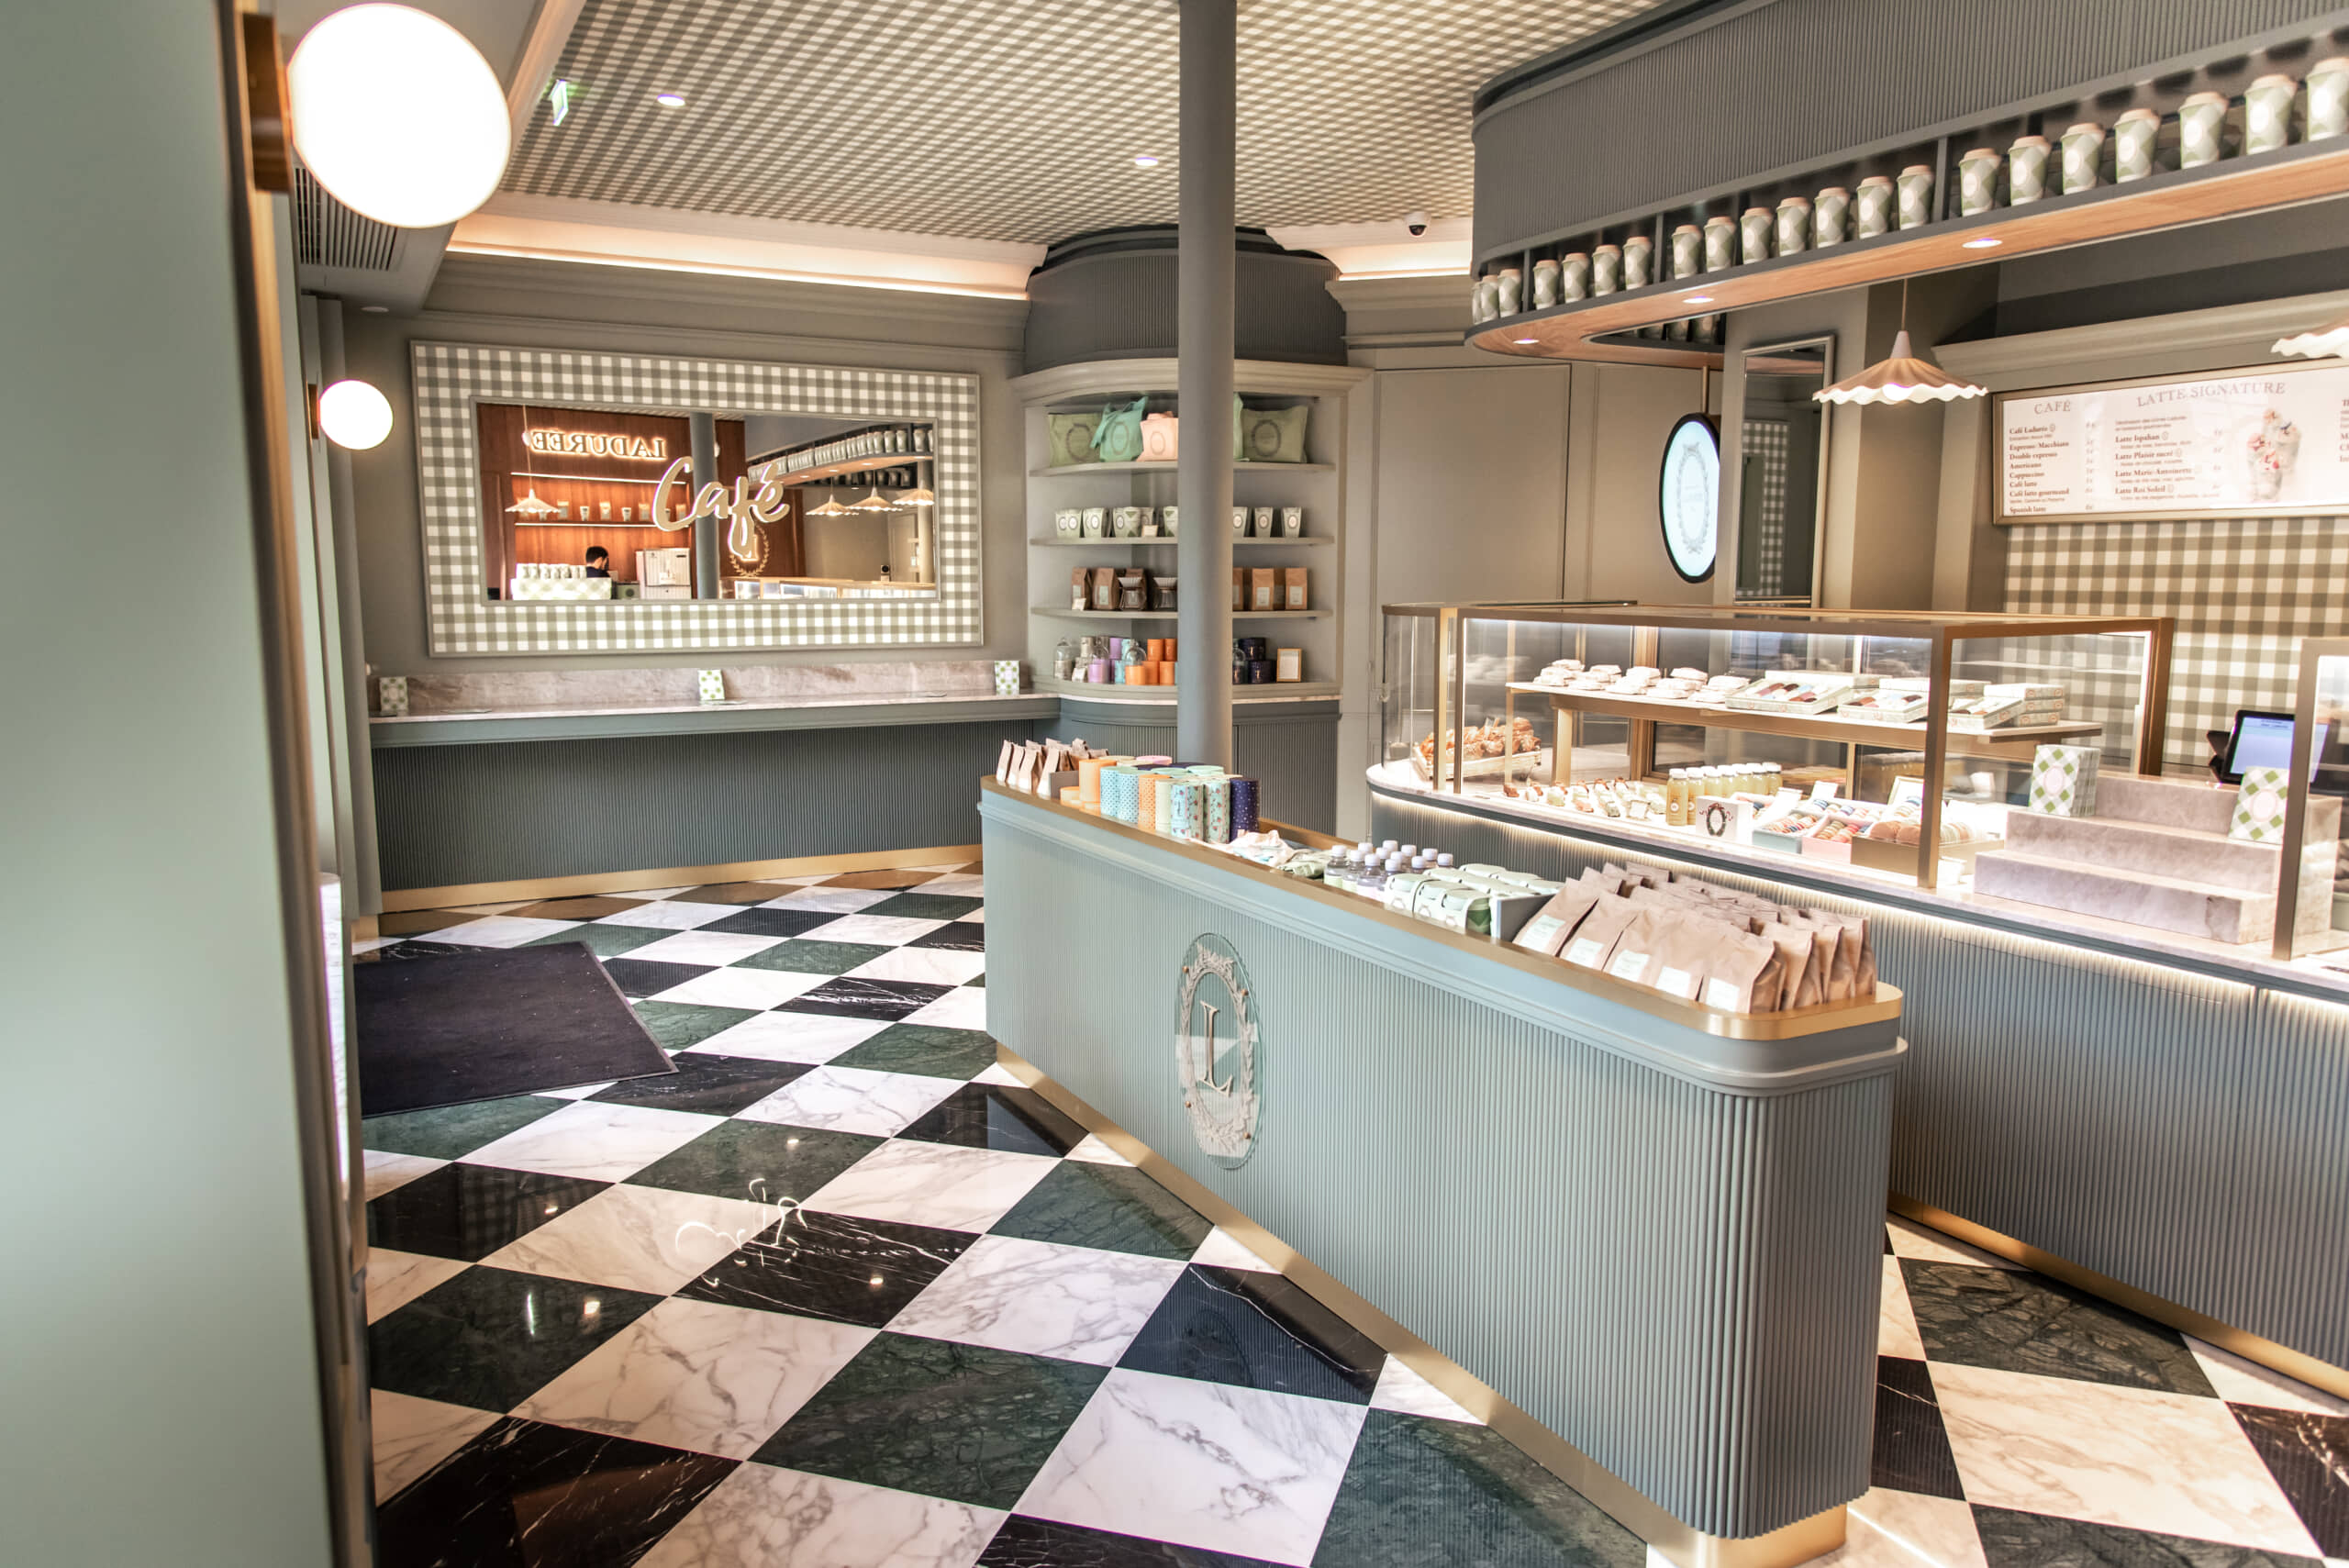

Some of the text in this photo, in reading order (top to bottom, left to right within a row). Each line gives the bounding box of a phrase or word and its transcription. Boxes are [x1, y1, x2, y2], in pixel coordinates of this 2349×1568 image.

[2136, 382, 2286, 407] LATTE SIGNATURE
[2114, 435, 2132, 444] Latte
[2114, 452, 2132, 461] Latte
[2114, 486, 2132, 495] Latte
[651, 455, 791, 559] Café
[1197, 999, 1234, 1098] L
